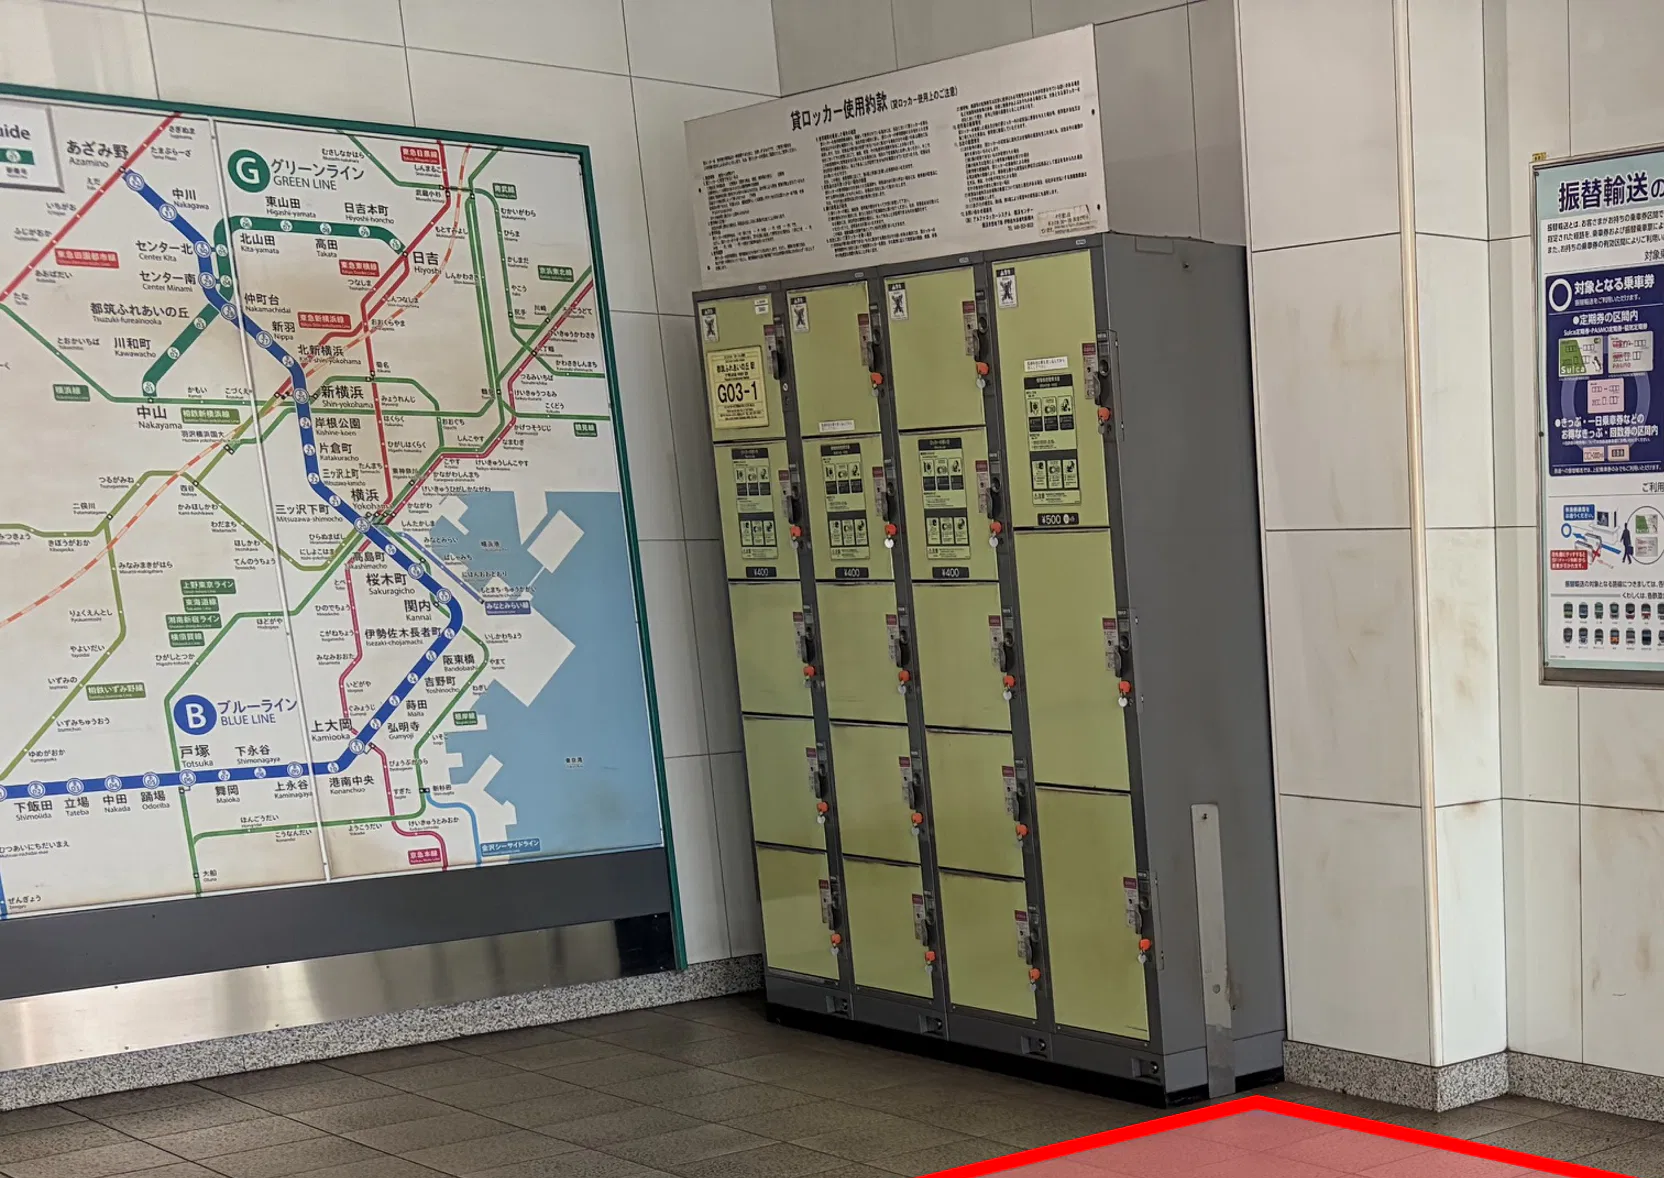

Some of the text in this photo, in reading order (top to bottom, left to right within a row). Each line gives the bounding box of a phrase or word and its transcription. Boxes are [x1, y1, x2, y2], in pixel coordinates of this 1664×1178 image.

[791, 91, 888, 131] 貸ロッカー使用約款
[67, 141, 129, 159] あざみ野
[69, 157, 108, 168] Azamino
[236, 156, 262, 183] G
[271, 159, 364, 179] グリーンライン
[273, 178, 337, 190] GREEN LINE
[172, 189, 196, 200] 中川
[173, 201, 209, 210] Nakagawa
[266, 196, 300, 209] 東山田
[267, 209, 316, 218] Higashi-yamata
[344, 202, 388, 216] 日吉本町
[240, 234, 275, 246] 北山田
[315, 238, 338, 250] 高田
[136, 241, 192, 255] センター北
[139, 253, 177, 262] Center Kita
[316, 250, 337, 258] Takata
[413, 252, 439, 265] 日吉
[414, 266, 441, 275] Hiyoshi
[139, 271, 196, 284] センター南
[142, 283, 192, 293] Center Minami
[1574, 274, 1655, 295] 対象となる乗車券
[244, 293, 279, 305] 仲町台
[91, 303, 189, 318] 都筑ふれあいの丘
[245, 305, 291, 314] Nakamachidai
[272, 321, 295, 332] 新羽
[274, 333, 293, 341] Nippa
[114, 338, 151, 349] 川和町
[115, 350, 156, 358] Kawawacho
[298, 345, 343, 358] 北新横浜
[322, 386, 363, 399] 新横浜
[718, 381, 757, 403] G03-1
[322, 401, 373, 409] Shin-yokohama
[138, 406, 167, 419] 中山
[138, 420, 182, 430] Nakayama
[315, 418, 361, 429] 岸根公園
[319, 442, 352, 454] 片倉町
[320, 453, 359, 462] Katakuracho
[351, 489, 379, 502] 横浜
[353, 502, 392, 511] Yokohama
[352, 551, 385, 563] 高島町
[753, 568, 769, 577] ¥400
[844, 568, 860, 577] ¥400
[942, 568, 959, 577] ¥400
[366, 573, 407, 586] 桜木町
[369, 586, 415, 596] Sakuragicho
[404, 600, 432, 612] 関内
[406, 613, 431, 621] Kannai
[365, 627, 441, 639] 伊勢佐木長者町
[443, 654, 475, 665] 阪東橋
[424, 676, 456, 687] 吉野町
[218, 699, 298, 715] ブルーライン
[186, 703, 205, 728] B
[221, 714, 275, 726] BLUE LINE
[311, 719, 352, 732] 上大岡
[388, 722, 419, 732] 弘明寺
[312, 732, 350, 742] Kamiooka
[389, 732, 414, 740] Gumyoji
[180, 745, 210, 758] 戸塚
[235, 745, 270, 756] 下永谷
[182, 758, 213, 767] Totsuka
[237, 756, 280, 765] Shimonagaya
[275, 781, 308, 791] 上永谷
[329, 776, 374, 788] 港南中央
[215, 785, 239, 796] 舞岡
[275, 791, 313, 799] Kaminagaya
[330, 786, 365, 794] Konanchuo
[65, 797, 89, 808] 立場
[103, 795, 127, 805] 中田
[142, 801, 170, 810] Odoriba
[14, 801, 52, 813] 下飯田
[66, 808, 89, 816] Tateba
[104, 805, 131, 813] Nakada
